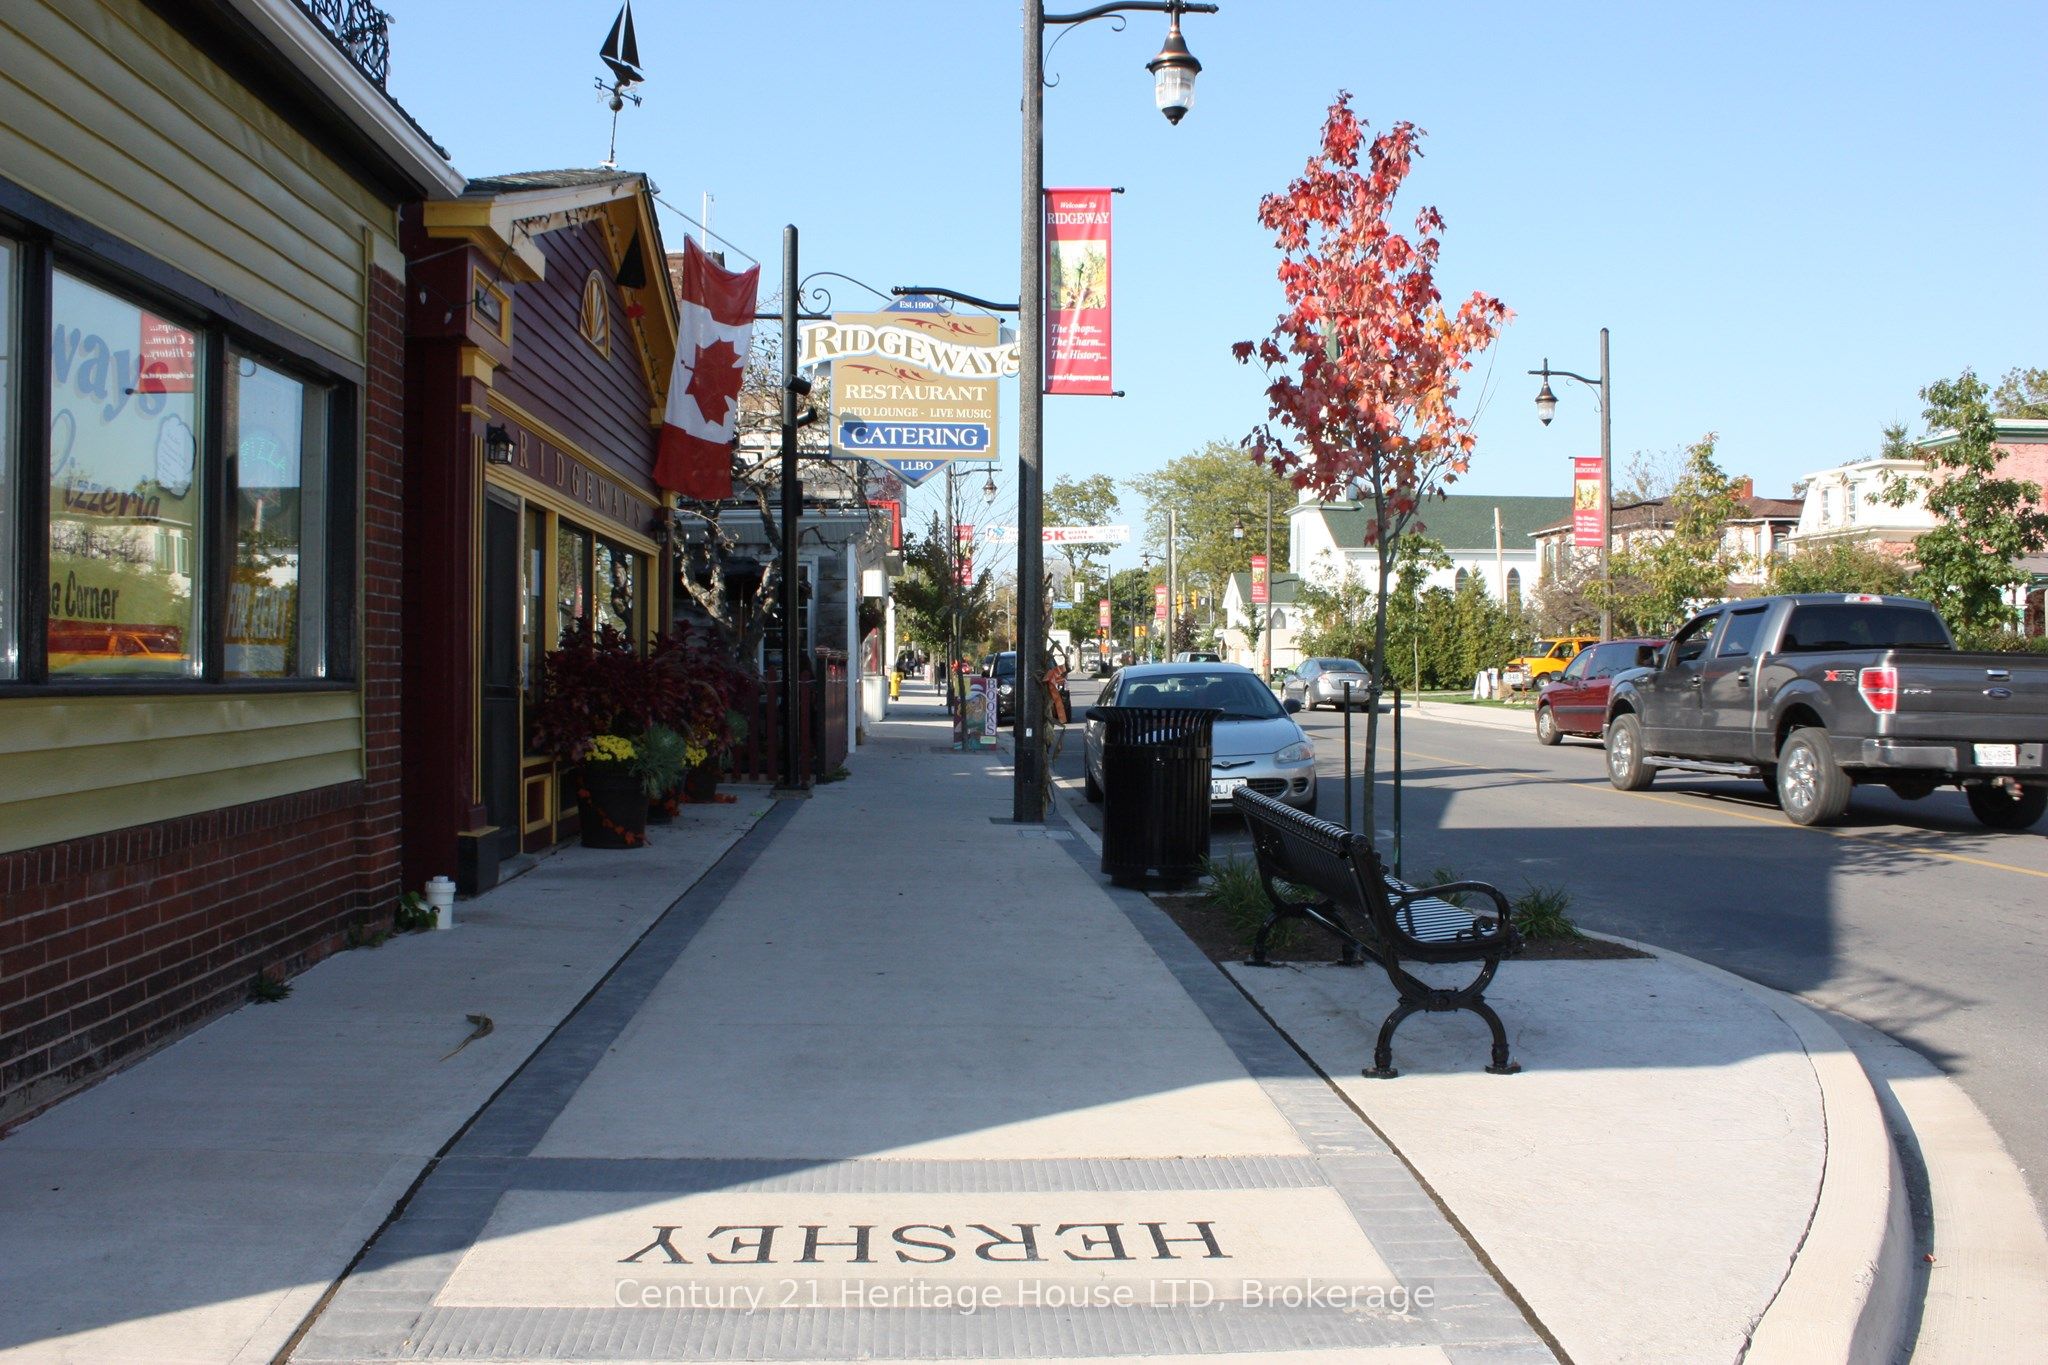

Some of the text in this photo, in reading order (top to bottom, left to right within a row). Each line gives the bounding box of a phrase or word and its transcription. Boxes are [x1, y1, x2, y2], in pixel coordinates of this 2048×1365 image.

[1047, 212, 1110, 224] RIDGEWAY
[1051, 323, 1067, 333] The
[1051, 336, 1067, 346] The
[806, 325, 1020, 375] RIDGEWAYS
[1051, 349, 1067, 360] The
[845, 384, 987, 401] RESTAURANT
[839, 406, 871, 417] PATIO
[873, 407, 918, 417] LOUNGE
[930, 408, 954, 417] LIVE
[956, 408, 992, 419] MUSIC
[851, 426, 979, 446] CATERING
[900, 460, 934, 471] LLBO
[518, 430, 641, 528] RIDGEWAYS
[64, 570, 120, 620] Corner
[986, 679, 995, 736] BOOKS
[617, 1220, 1233, 1265] HERSHEY
